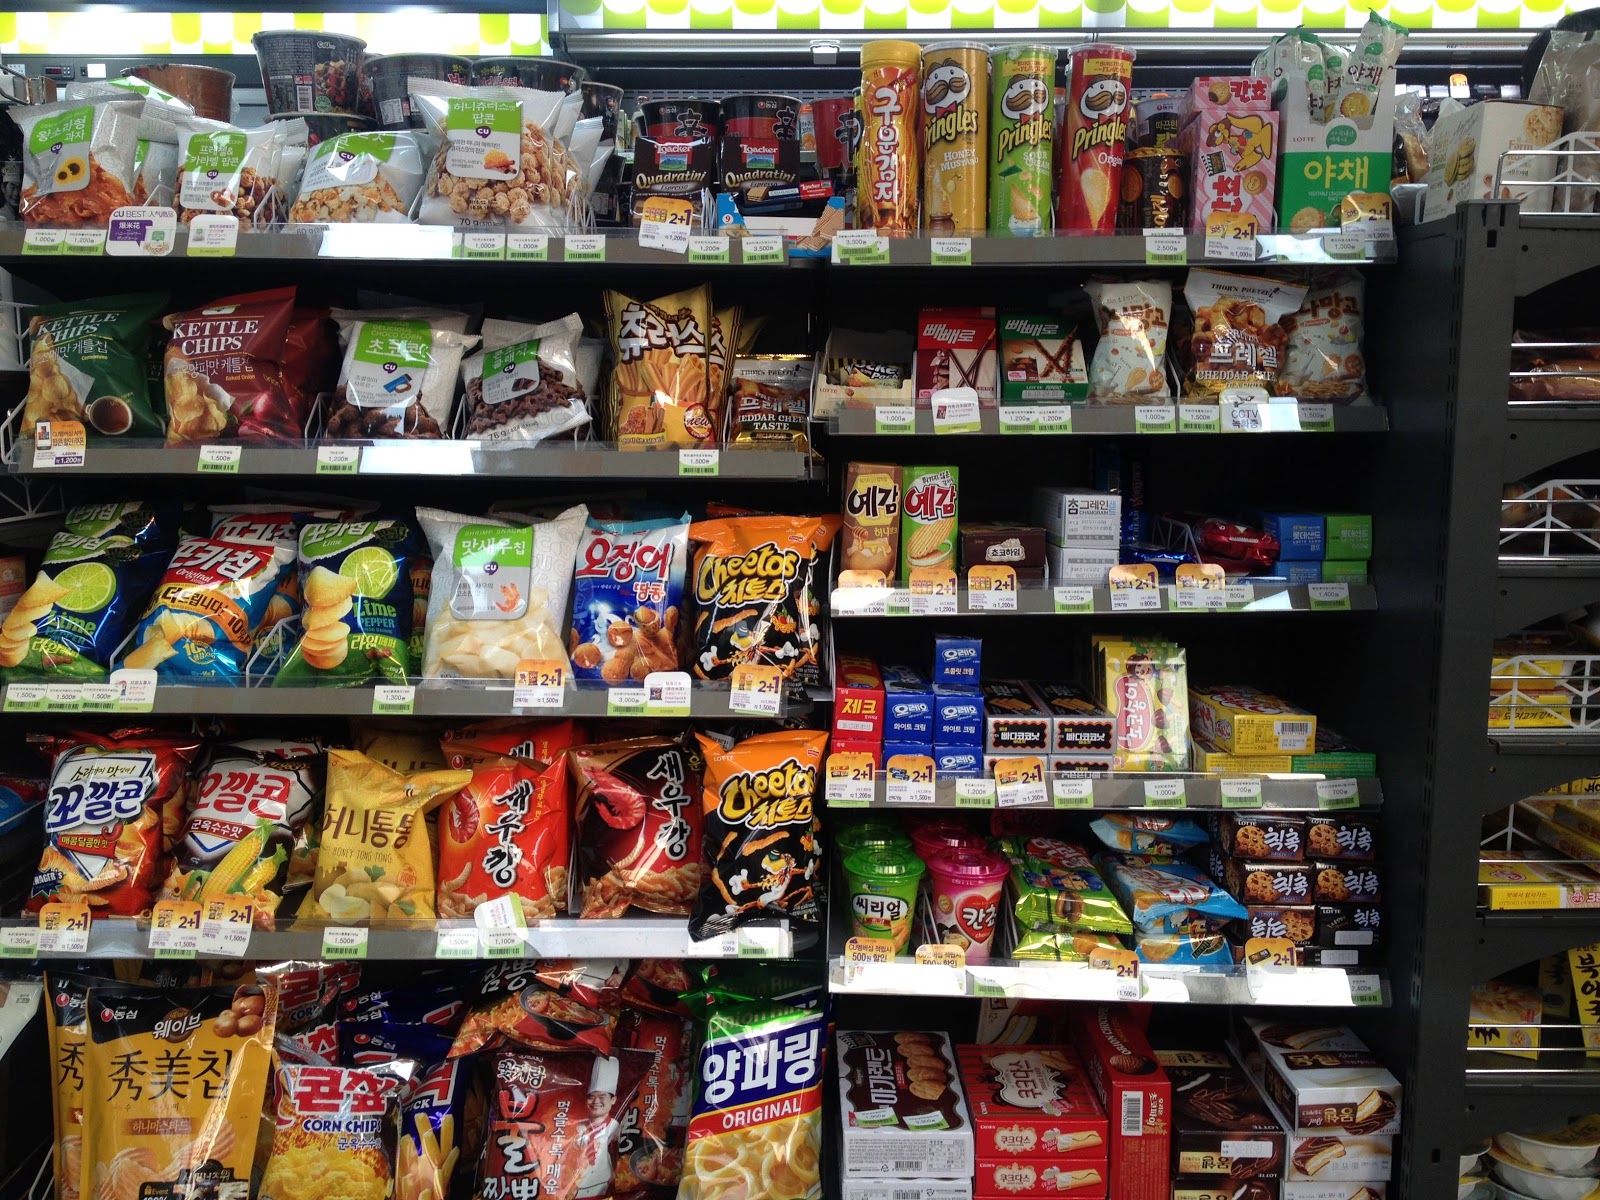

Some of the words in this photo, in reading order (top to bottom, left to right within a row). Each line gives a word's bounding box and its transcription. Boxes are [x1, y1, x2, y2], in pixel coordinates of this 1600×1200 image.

[1347, 62, 1383, 86] 야채
[1230, 79, 1267, 101] 칸쵸
[472, 113, 496, 125] 팝콘
[873, 86, 903, 204] 구운감자
[998, 114, 1052, 163] Pringles
[1072, 115, 1126, 161] Pringles
[740, 144, 778, 154] Loacker
[943, 149, 977, 162] HONEY
[1023, 150, 1048, 160] SOUR
[190, 155, 219, 166] 카라멜
[222, 156, 239, 167] 팝콘
[940, 156, 979, 172] MUSTARD
[1025, 158, 1050, 169] CREAM
[635, 170, 707, 190] Quadratini
[725, 169, 796, 190] Quadratini
[1303, 155, 1369, 190] 야채
[660, 183, 688, 191] Espresso
[1211, 283, 1238, 293] THOR'S
[1241, 287, 1275, 299] PRETZEL
[37, 312, 119, 336] KETTLE
[46, 322, 100, 345] CHIPS
[171, 319, 259, 340] KETTLE
[618, 302, 710, 363] 츄러스
[923, 323, 976, 344] 빼빼로
[1005, 319, 1060, 337] 빼빼로
[181, 335, 243, 356] CHIPS
[372, 331, 399, 339] CHOCO
[400, 333, 422, 341] CORN
[221, 356, 254, 374] 케틀칩
[1209, 341, 1278, 370] 프레첼
[504, 364, 515, 372] CU
[1196, 370, 1250, 381] CHEDDAR
[741, 396, 806, 414] 프레첼
[1231, 409, 1259, 419] CCTV
[753, 422, 790, 431] TASTE
[1231, 419, 1259, 429] 녹화중
[848, 484, 900, 519] 예감
[904, 484, 957, 521] 예감
[51, 532, 105, 551] 포카칩
[303, 521, 373, 547] 포카칩
[464, 529, 493, 537] SHRIMP
[496, 527, 527, 535] SNACKS
[1292, 530, 1321, 540] 롯데샌드
[322, 538, 343, 548] Lime
[461, 537, 526, 557] 맛새우칩
[991, 548, 1021, 557] 쵸코하임
[167, 540, 261, 581] 포카칩
[484, 563, 497, 571] CU
[575, 537, 674, 582] 오징어
[175, 567, 214, 583] Original
[697, 542, 802, 602] Cheetos
[633, 581, 666, 602] 땅콩
[718, 579, 788, 606] 치토스
[351, 600, 398, 618] Lime
[48, 610, 97, 635] Lime
[359, 617, 396, 629] PEPPER
[942, 647, 977, 663] 오레오
[540, 667, 562, 686] 2+1
[841, 698, 877, 715] 제크
[892, 702, 929, 718] 오레오
[941, 705, 978, 720] 오레오
[913, 723, 927, 732] 크림
[942, 725, 962, 733] 화이트
[963, 726, 976, 734] 크림
[1000, 731, 1041, 741] 빠다코코낫
[1065, 732, 1106, 742] 빠다코코낫
[852, 762, 874, 781] 2+1
[911, 764, 933, 783] 2+1
[1021, 764, 1043, 785] 2+1
[197, 771, 291, 820] 꼬깔콘
[717, 757, 817, 826] Cheetos
[47, 779, 144, 830] 꼬깔콘
[647, 750, 691, 861] 새우깡
[746, 796, 814, 829] 치토스
[190, 819, 243, 838] 군옥수수맛
[321, 802, 415, 850] 허니통통
[482, 778, 534, 889] 새우깡
[101, 840, 108, 848] 맛
[1336, 825, 1373, 852] 칙촉
[332, 847, 355, 858] HONEY
[356, 850, 372, 862] TONG
[374, 852, 393, 864] TONG
[1272, 871, 1309, 897] 칙촉
[1344, 869, 1379, 895] 칙촉
[230, 905, 252, 924] 2+1
[855, 896, 901, 921] 씨리얼
[962, 902, 997, 931] 칸쵸
[67, 912, 88, 931] 2+1
[178, 910, 200, 929] 2+1
[852, 952, 872, 962] 500원
[873, 953, 888, 963] 할인
[874, 945, 892, 953] 적립시
[1117, 959, 1139, 978] 2+1
[113, 1008, 139, 1021] 농심
[152, 1011, 202, 1041] 웨이브
[107, 1048, 233, 1103] 秀美칩
[496, 1058, 546, 1088] 꽃게랑
[702, 1028, 819, 1106] 양파링
[865, 1047, 898, 1105] 마가렛트
[722, 1096, 802, 1131] ORIGINAL
[1146, 1091, 1158, 1126] 초코파이
[1323, 1106, 1354, 1124] 몽쉘
[132, 1118, 190, 1134] 허니머스타드
[303, 1119, 345, 1133] CORN
[345, 1119, 381, 1134] CHIPS
[549, 1100, 571, 1160] 먹을수록
[1000, 1134, 1031, 1144] 쿠크다스
[1200, 1155, 1230, 1170] 몽쉘
[543, 1163, 562, 1195] 매운
